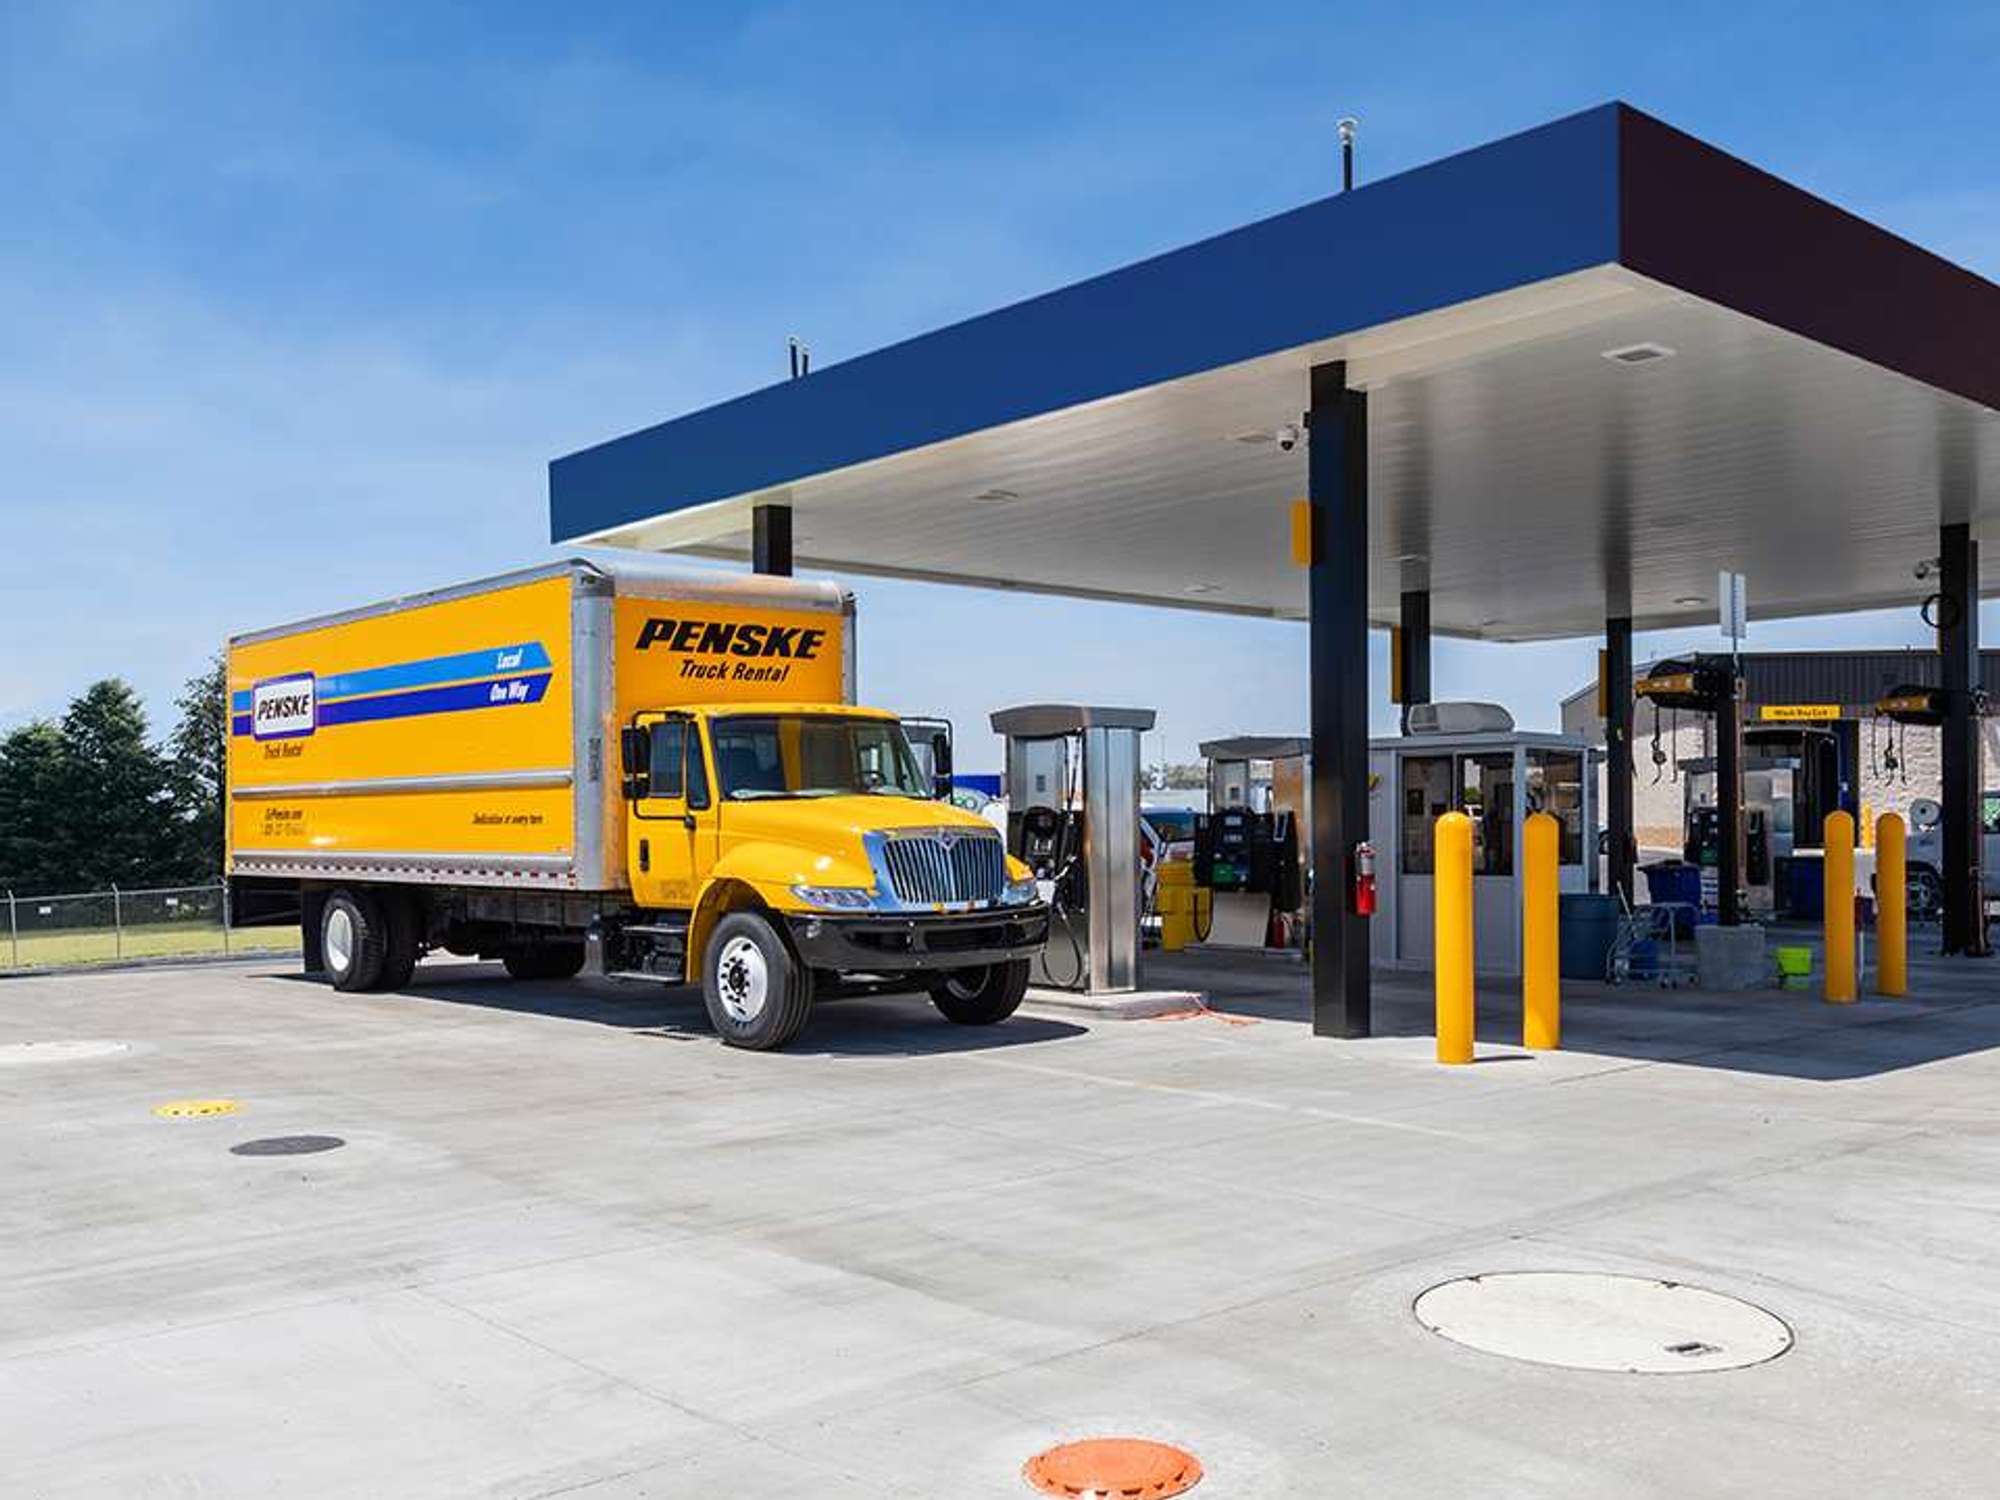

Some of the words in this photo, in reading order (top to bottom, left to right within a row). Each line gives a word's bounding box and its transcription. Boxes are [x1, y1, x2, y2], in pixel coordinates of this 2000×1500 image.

[635, 618, 826, 659] PENSKE
[496, 648, 523, 669] Local
[680, 659, 730, 679] Truck
[732, 662, 790, 682] Rental
[490, 683, 507, 701] One
[509, 680, 530, 701] Way
[257, 694, 310, 720] PENSKE
